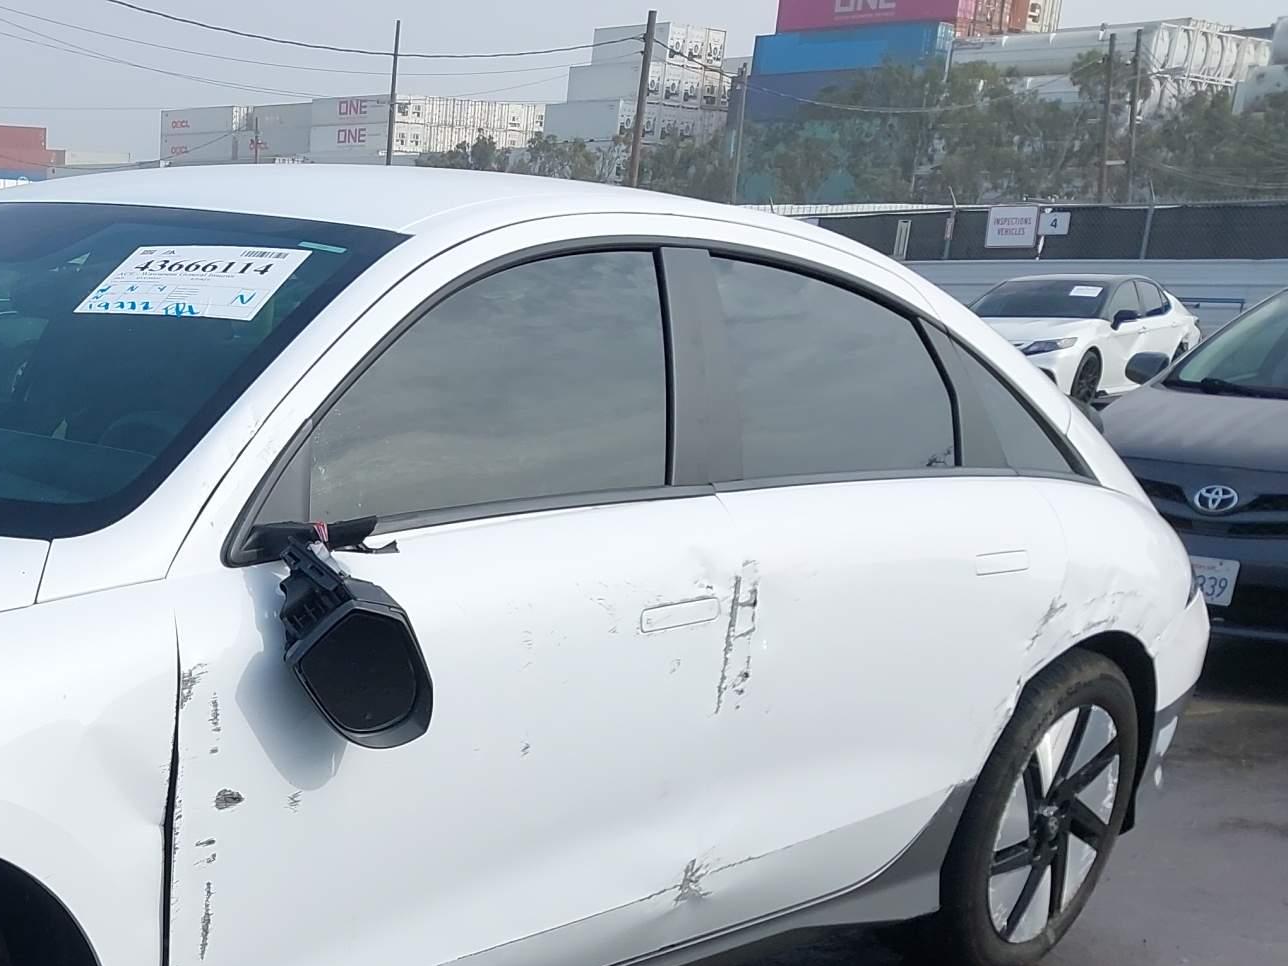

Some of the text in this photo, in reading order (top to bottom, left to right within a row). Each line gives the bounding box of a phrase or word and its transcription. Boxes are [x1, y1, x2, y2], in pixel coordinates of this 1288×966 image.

[338, 99, 368, 116] ONE
[337, 127, 367, 144] ONE
[1050, 218, 1058, 228] 4
[998, 228, 1025, 236] VEHICLES
[135, 259, 273, 275] 43666114
